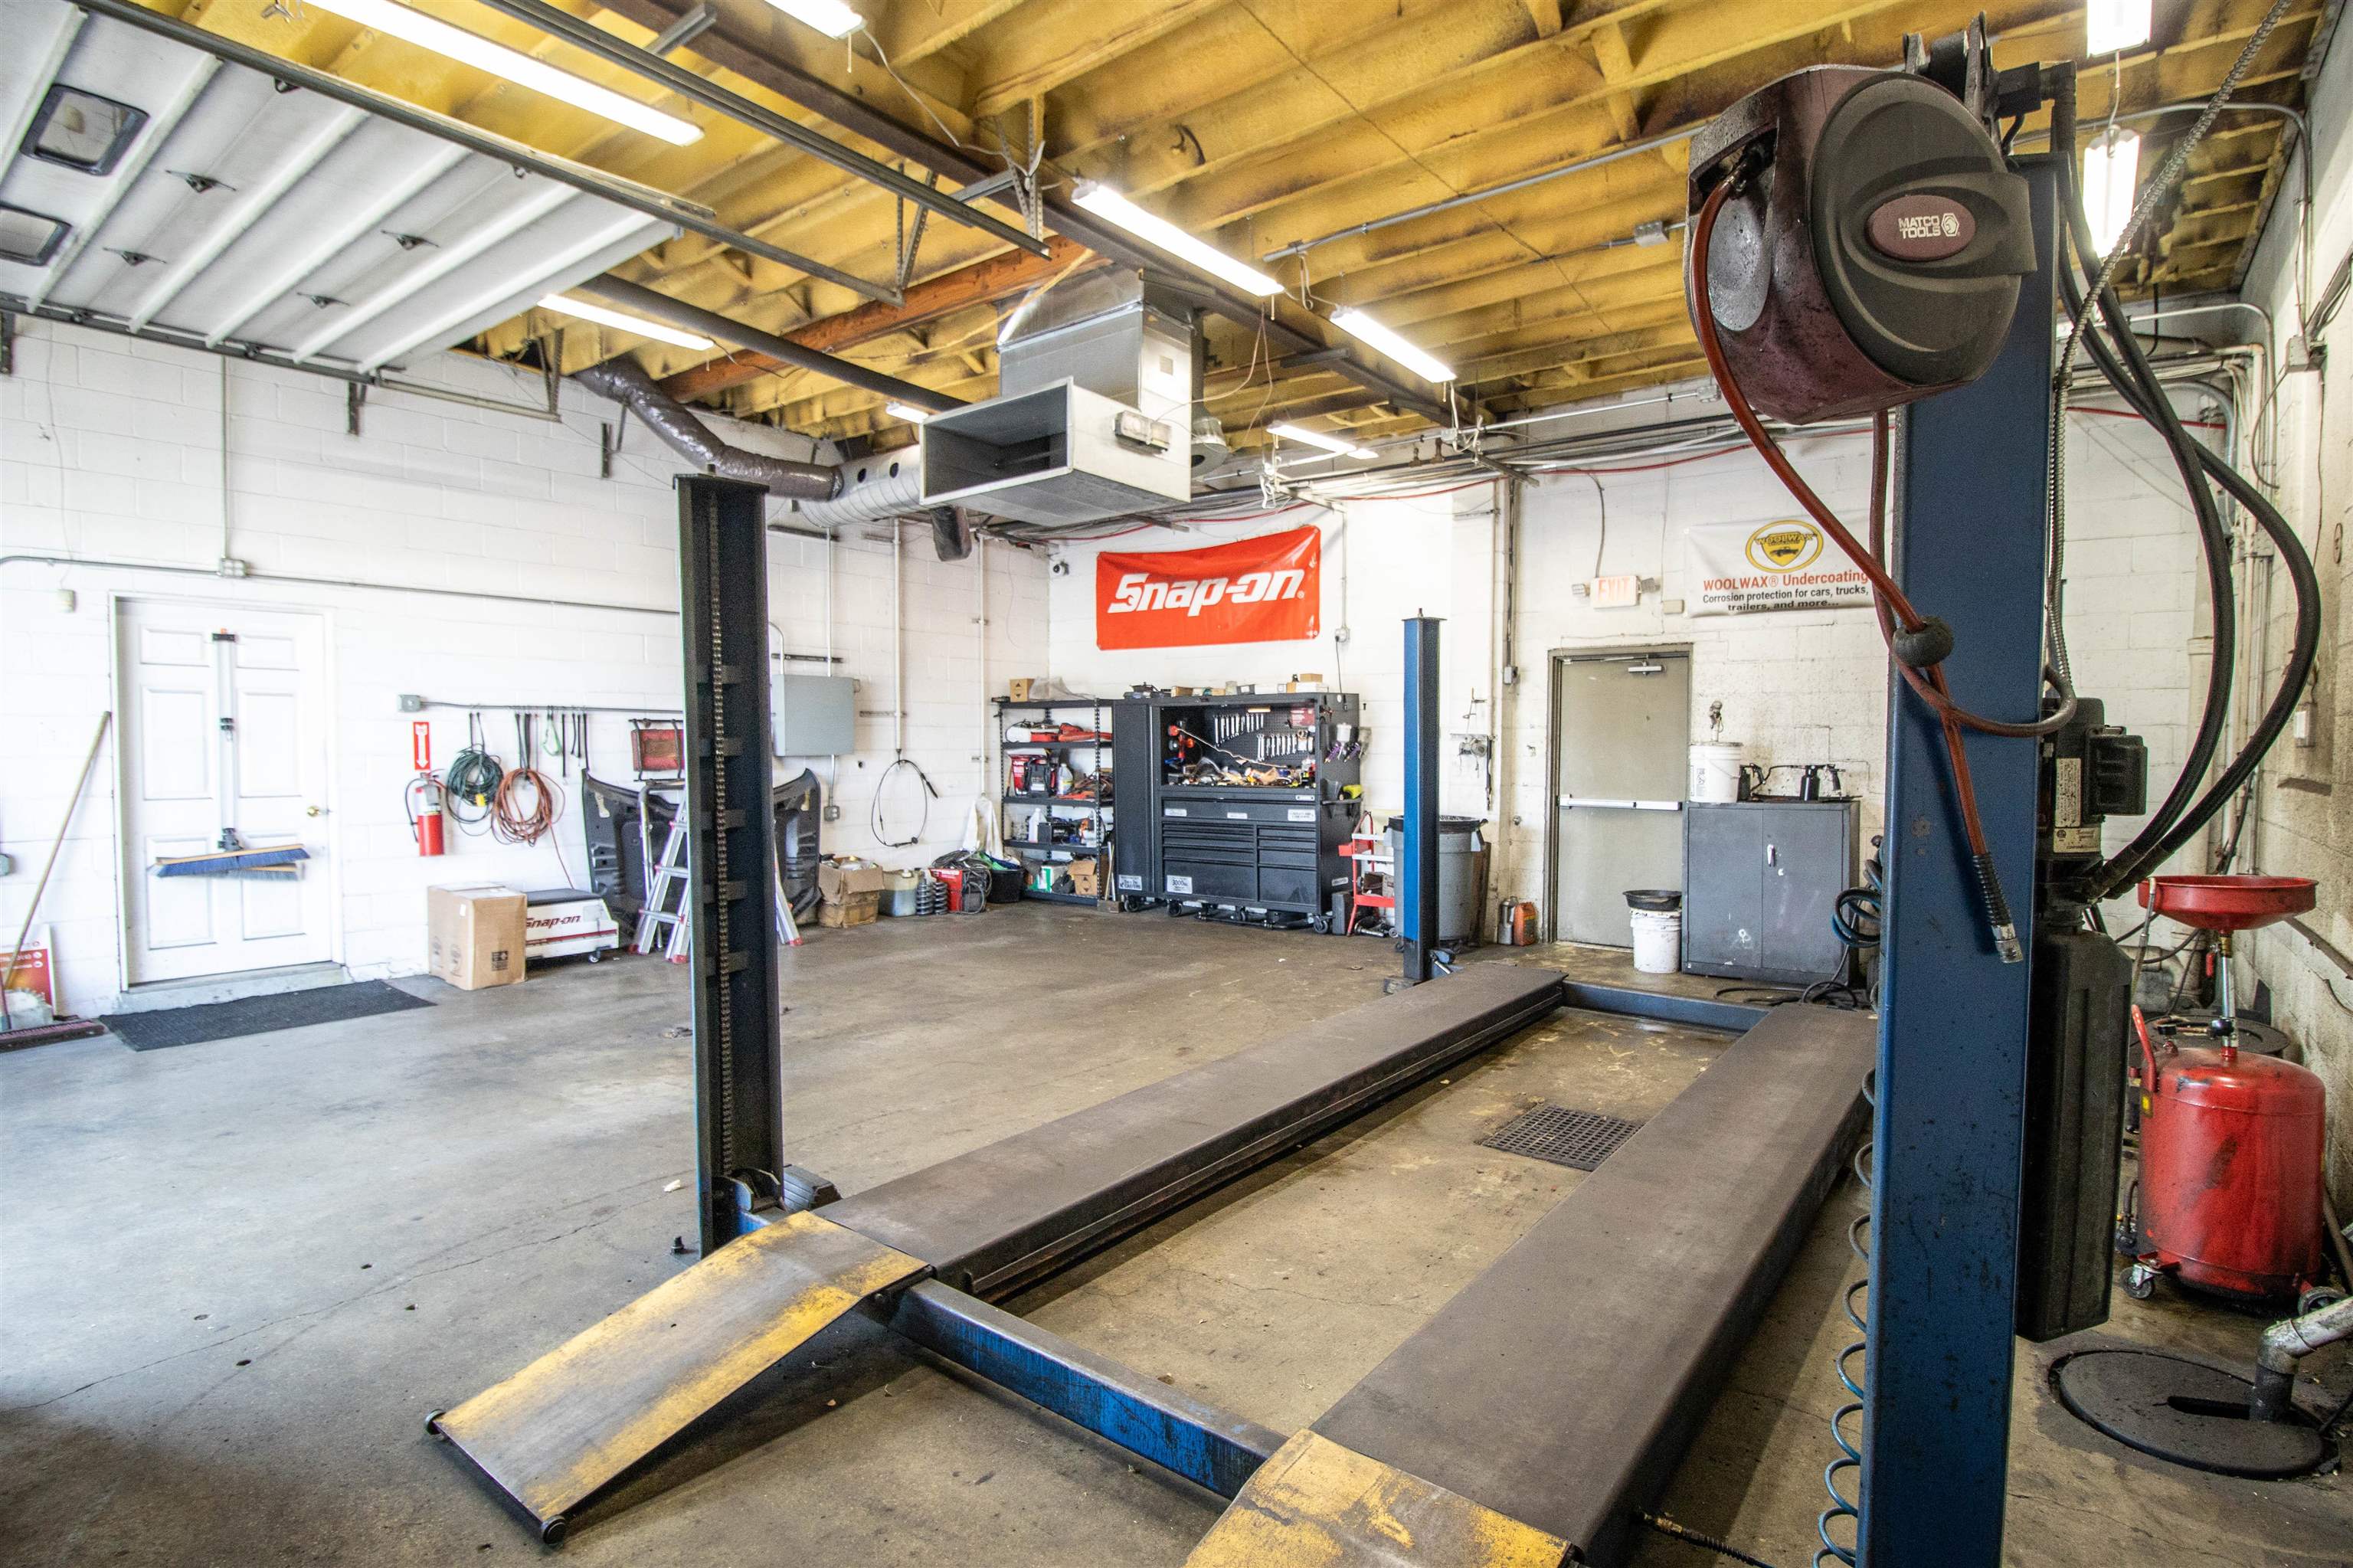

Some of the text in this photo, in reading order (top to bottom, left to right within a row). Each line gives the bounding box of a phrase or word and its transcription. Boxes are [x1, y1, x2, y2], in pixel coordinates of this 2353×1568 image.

[1899, 215, 1940, 228] MATCO
[1900, 226, 1942, 239] TOOLS
[1783, 569, 1869, 586] Undercoating
[1597, 577, 1631, 601] EXIT
[1703, 584, 1869, 604] Corrosion protection for cars, trucks,
[1728, 603, 1771, 612] trailers,
[1798, 599, 1840, 608] more...
[526, 915, 581, 928] Snap-on
